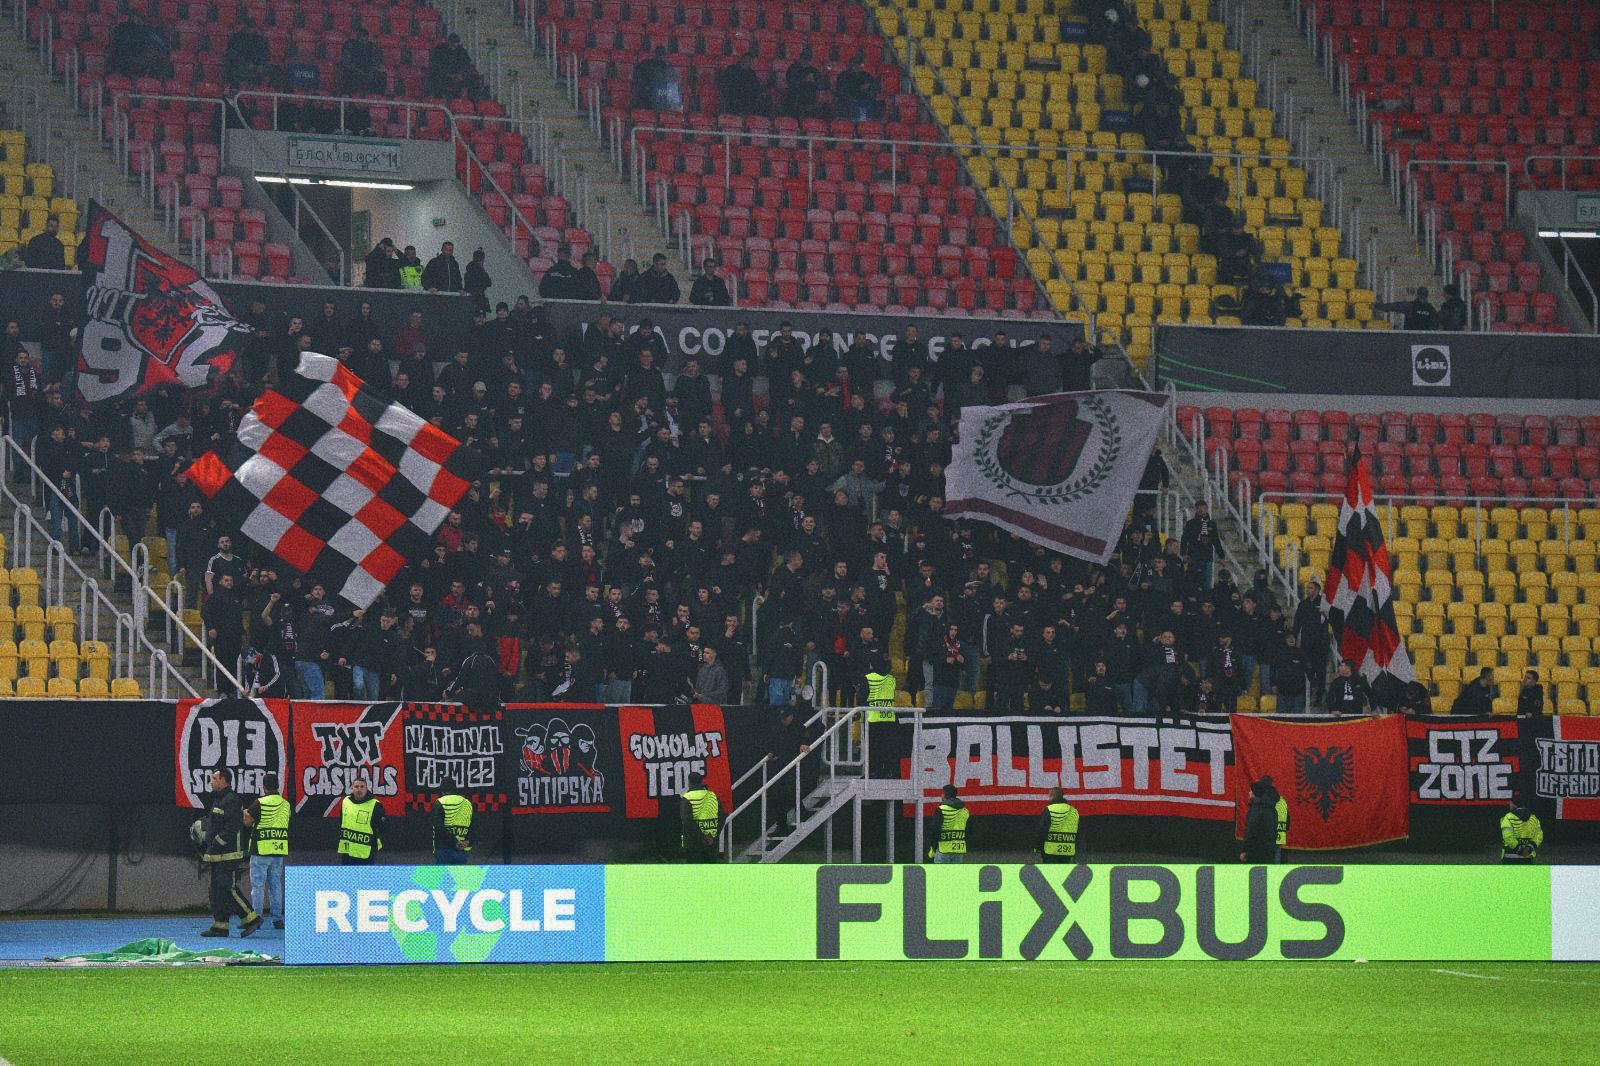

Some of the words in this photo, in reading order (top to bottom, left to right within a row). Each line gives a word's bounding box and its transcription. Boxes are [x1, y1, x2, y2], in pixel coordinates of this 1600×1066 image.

[312, 722, 385, 767] TXT
[630, 732, 722, 760] SOKOLAT
[912, 724, 1232, 795] BALLISTET
[1428, 729, 1499, 763] CTZ
[467, 757, 494, 787] 22
[1418, 763, 1513, 799] ZONE
[518, 776, 604, 805] SHTIPSKA
[315, 888, 576, 933] RECYCLE
